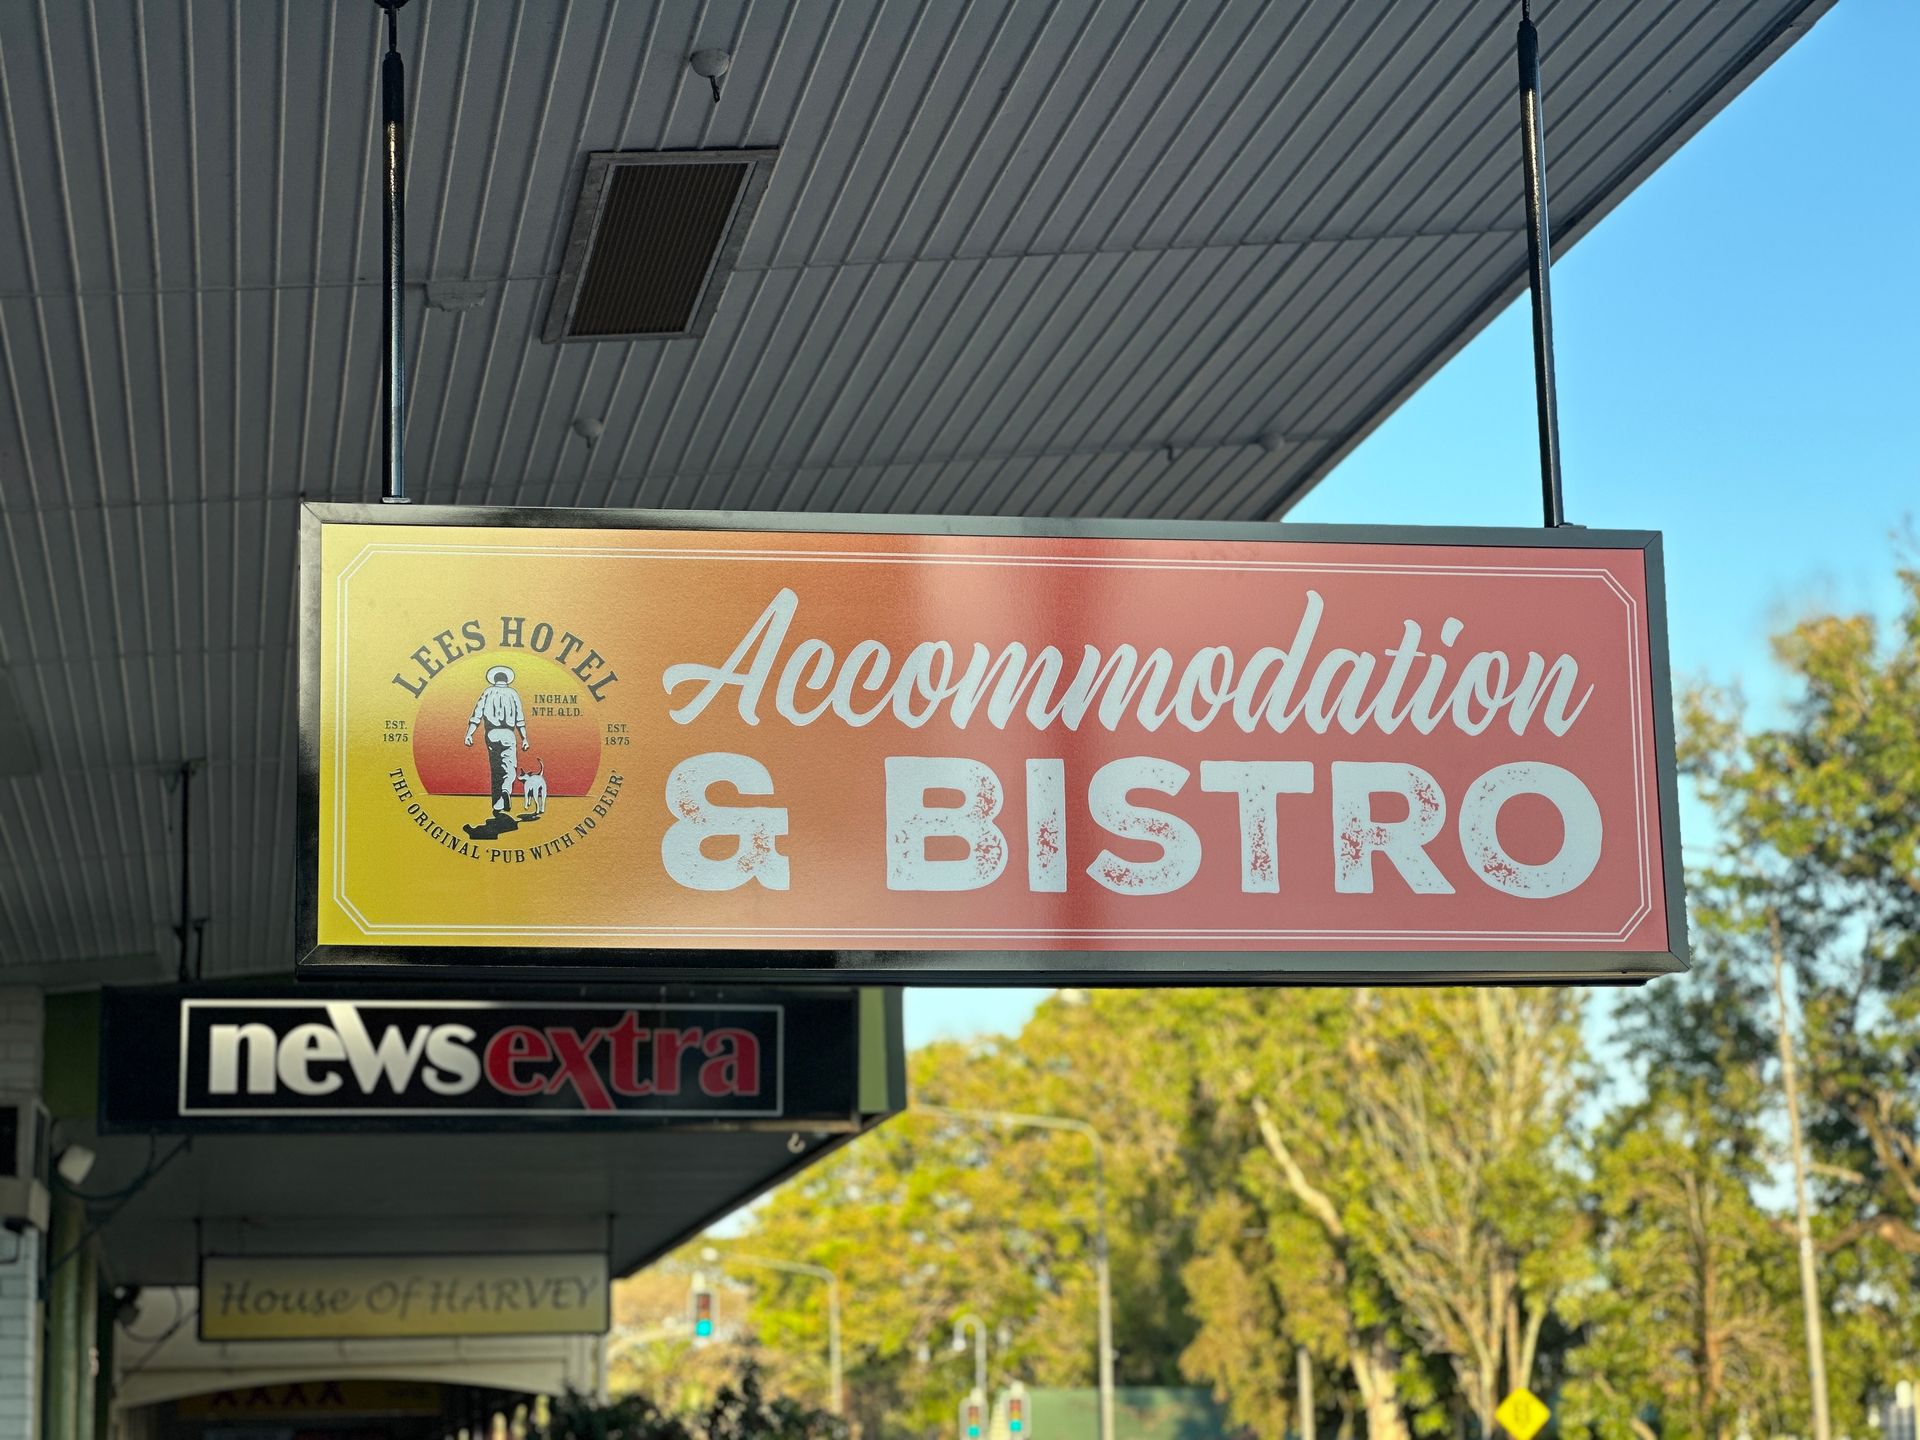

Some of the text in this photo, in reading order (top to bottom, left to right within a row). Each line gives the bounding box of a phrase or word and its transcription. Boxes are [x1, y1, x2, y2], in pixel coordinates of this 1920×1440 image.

[391, 616, 619, 703] LEES HOTEL
[663, 587, 1595, 737] Accommodation
[534, 694, 578, 704] INGHAM
[383, 732, 409, 742] 1875
[385, 720, 408, 730] EST.
[607, 723, 629, 733] EST.
[605, 736, 630, 746] 1875
[389, 767, 413, 803] THE
[407, 803, 480, 860] ORIGINAL
[529, 832, 576, 861] WITH
[573, 816, 597, 840] NO
[661, 751, 1603, 899] & BISTRO
[219, 1279, 351, 1317] House
[428, 1274, 598, 1315] HARVEY
